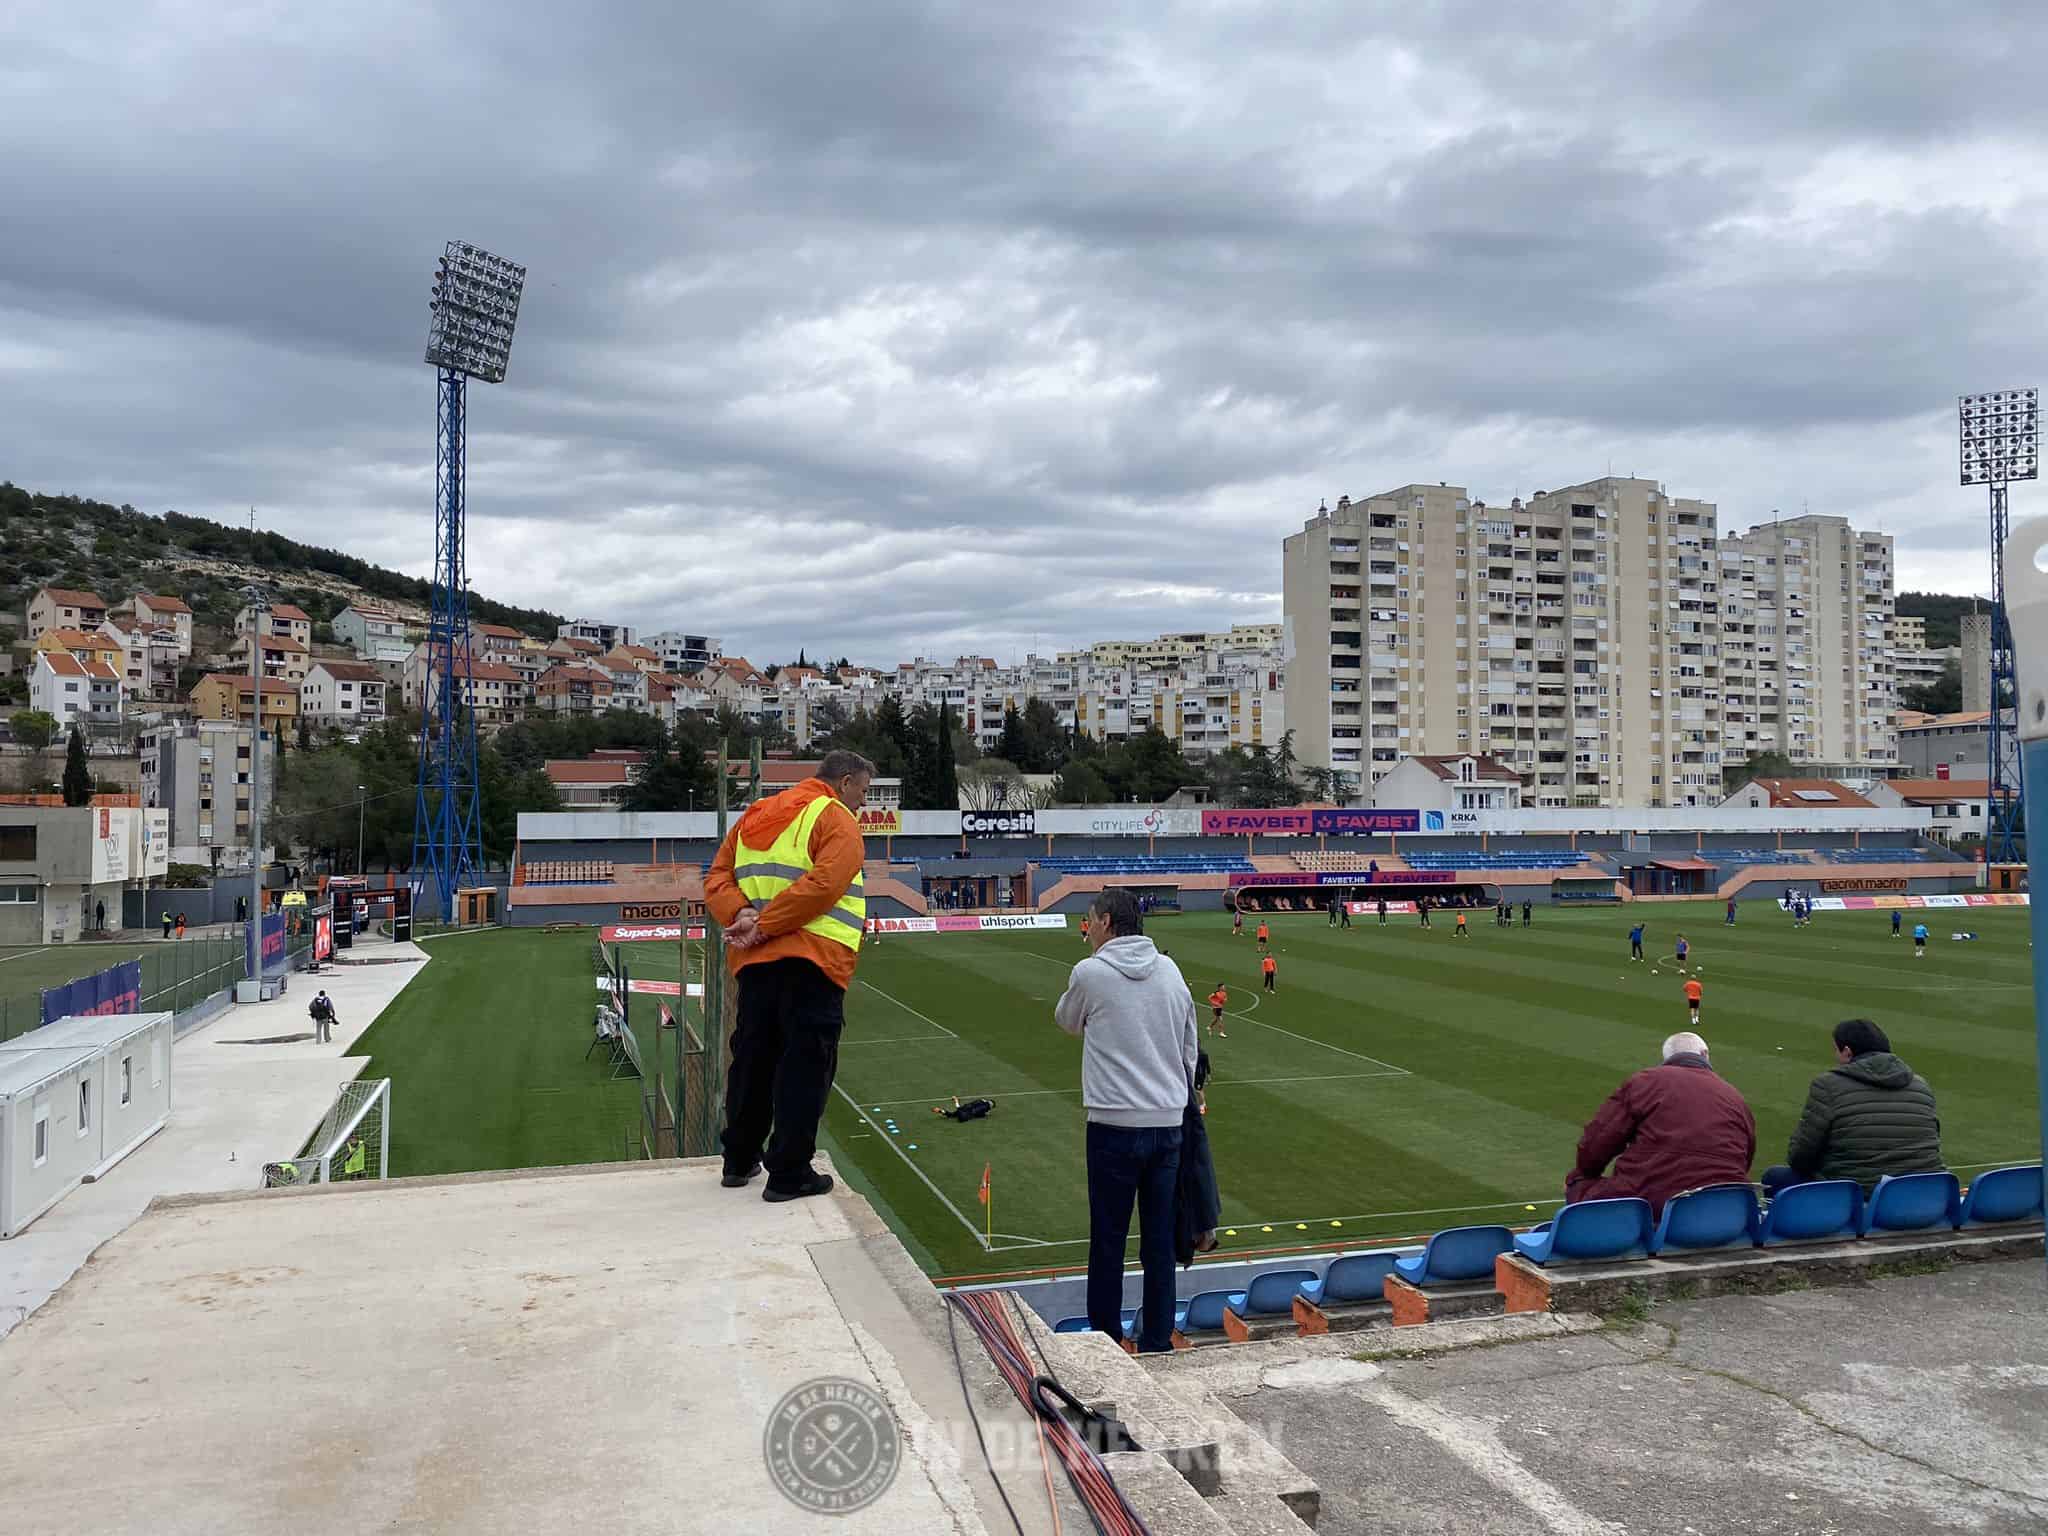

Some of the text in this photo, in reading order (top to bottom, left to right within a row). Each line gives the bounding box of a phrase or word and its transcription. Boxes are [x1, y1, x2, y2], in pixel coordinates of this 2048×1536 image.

[962, 814, 1034, 832] Ceresit
[1226, 816, 1307, 828] FAVBET
[1336, 816, 1416, 828] FAVBET
[1451, 813, 1477, 822] KRKA
[1092, 820, 1144, 831] CITYLIFE
[981, 916, 1035, 928] uhlsport
